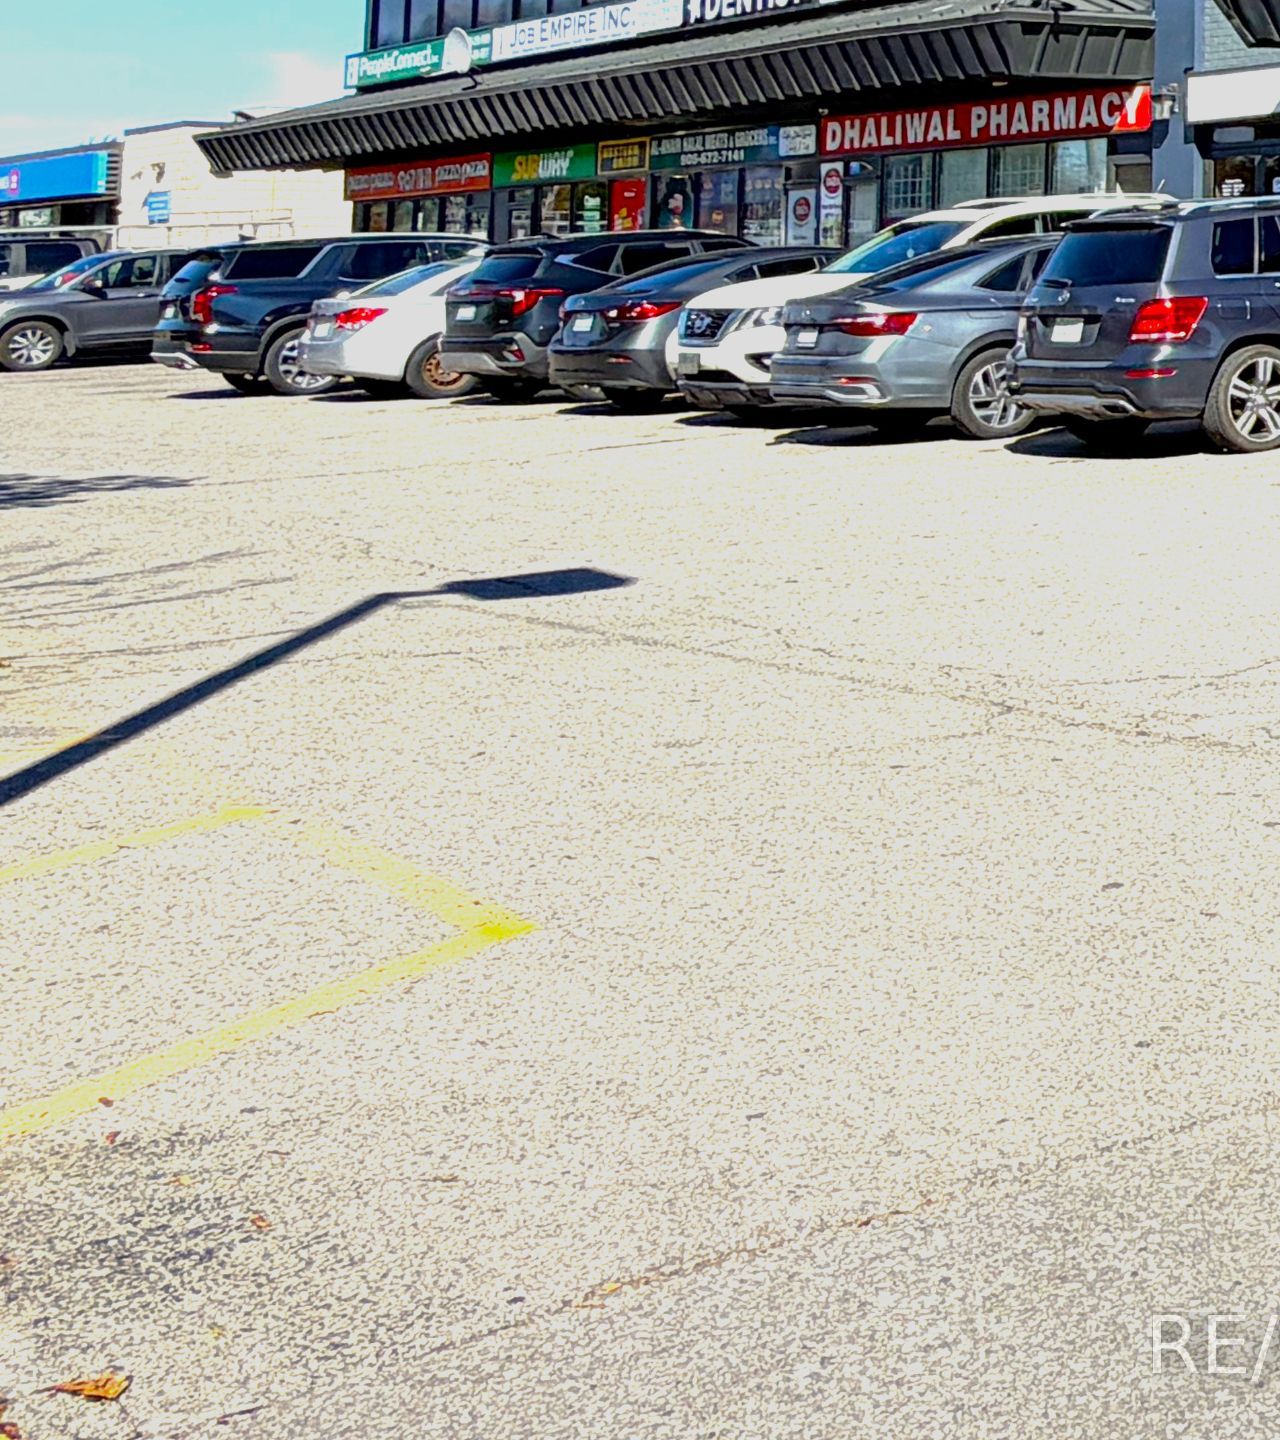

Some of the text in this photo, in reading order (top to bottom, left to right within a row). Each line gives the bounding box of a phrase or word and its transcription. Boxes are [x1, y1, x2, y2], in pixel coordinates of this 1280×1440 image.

[510, 23, 535, 47] JOB
[540, 11, 598, 42] EMPIRE
[825, 85, 1144, 152] DHALIWAL PHARMACY
[512, 149, 573, 180] SUBWAY
